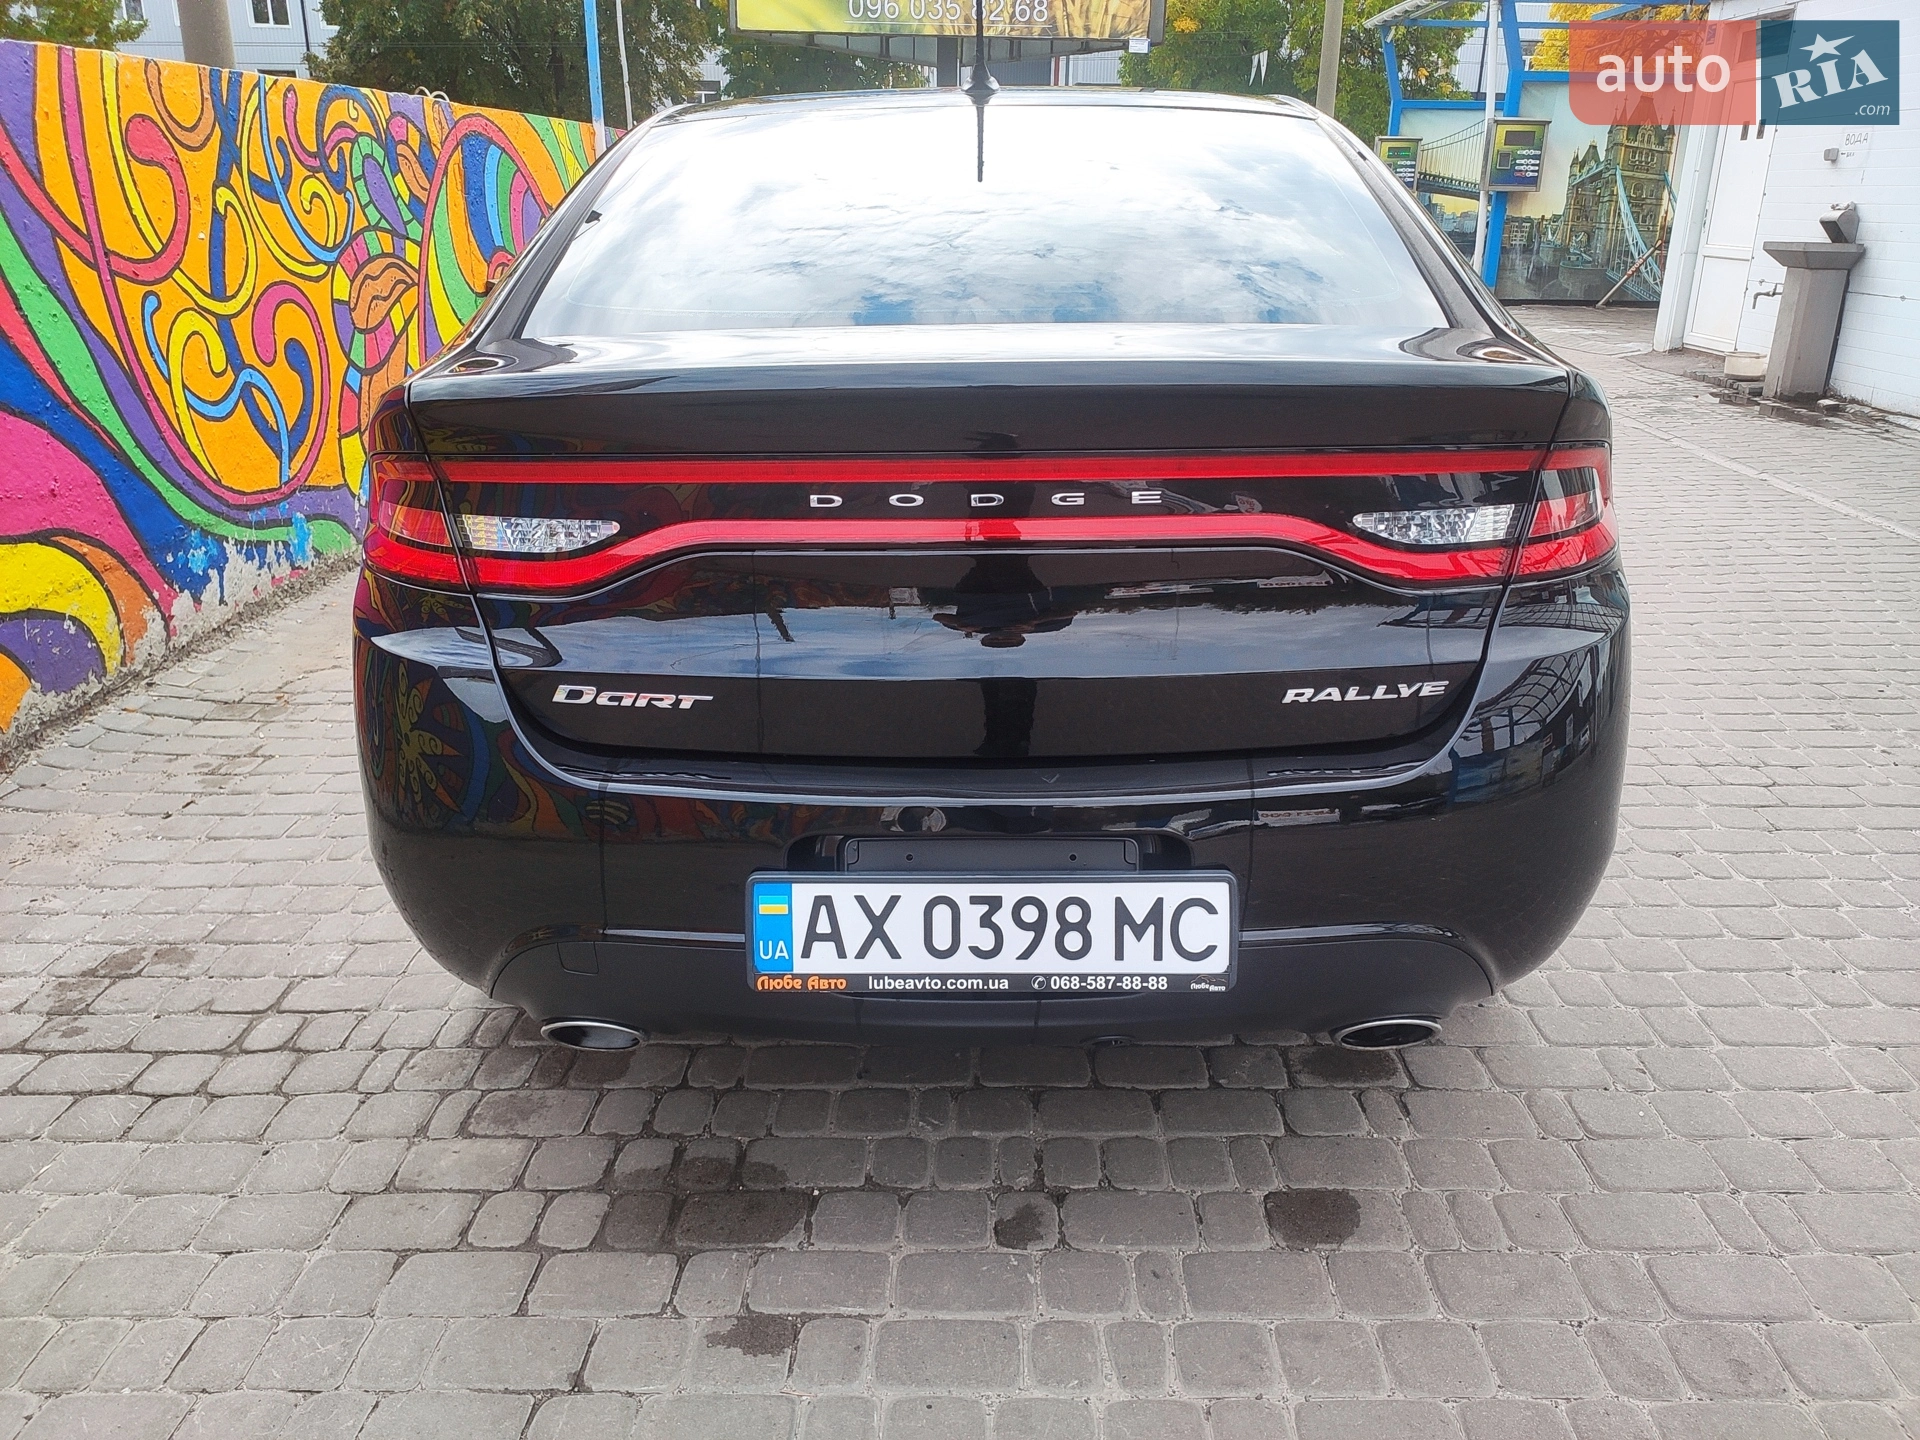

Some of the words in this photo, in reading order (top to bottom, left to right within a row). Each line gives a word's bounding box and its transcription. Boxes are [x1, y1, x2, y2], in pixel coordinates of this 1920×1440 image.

[849, 0, 899, 19] 096
[910, 0, 961, 20] 035
[1015, 0, 1048, 22] 68
[1845, 133, 1869, 146] ВОДА
[809, 490, 1163, 508] DODGE
[1281, 680, 1450, 704] RALLYE
[800, 895, 903, 960] AX
[923, 895, 1093, 961] 0398
[1114, 896, 1219, 962] MC
[759, 940, 790, 960] UA
[756, 974, 802, 991] Любе
[807, 975, 847, 991] Авто
[868, 976, 1009, 990] lubeavto.com.ua
[1050, 976, 1168, 991] 068-587-88-88
